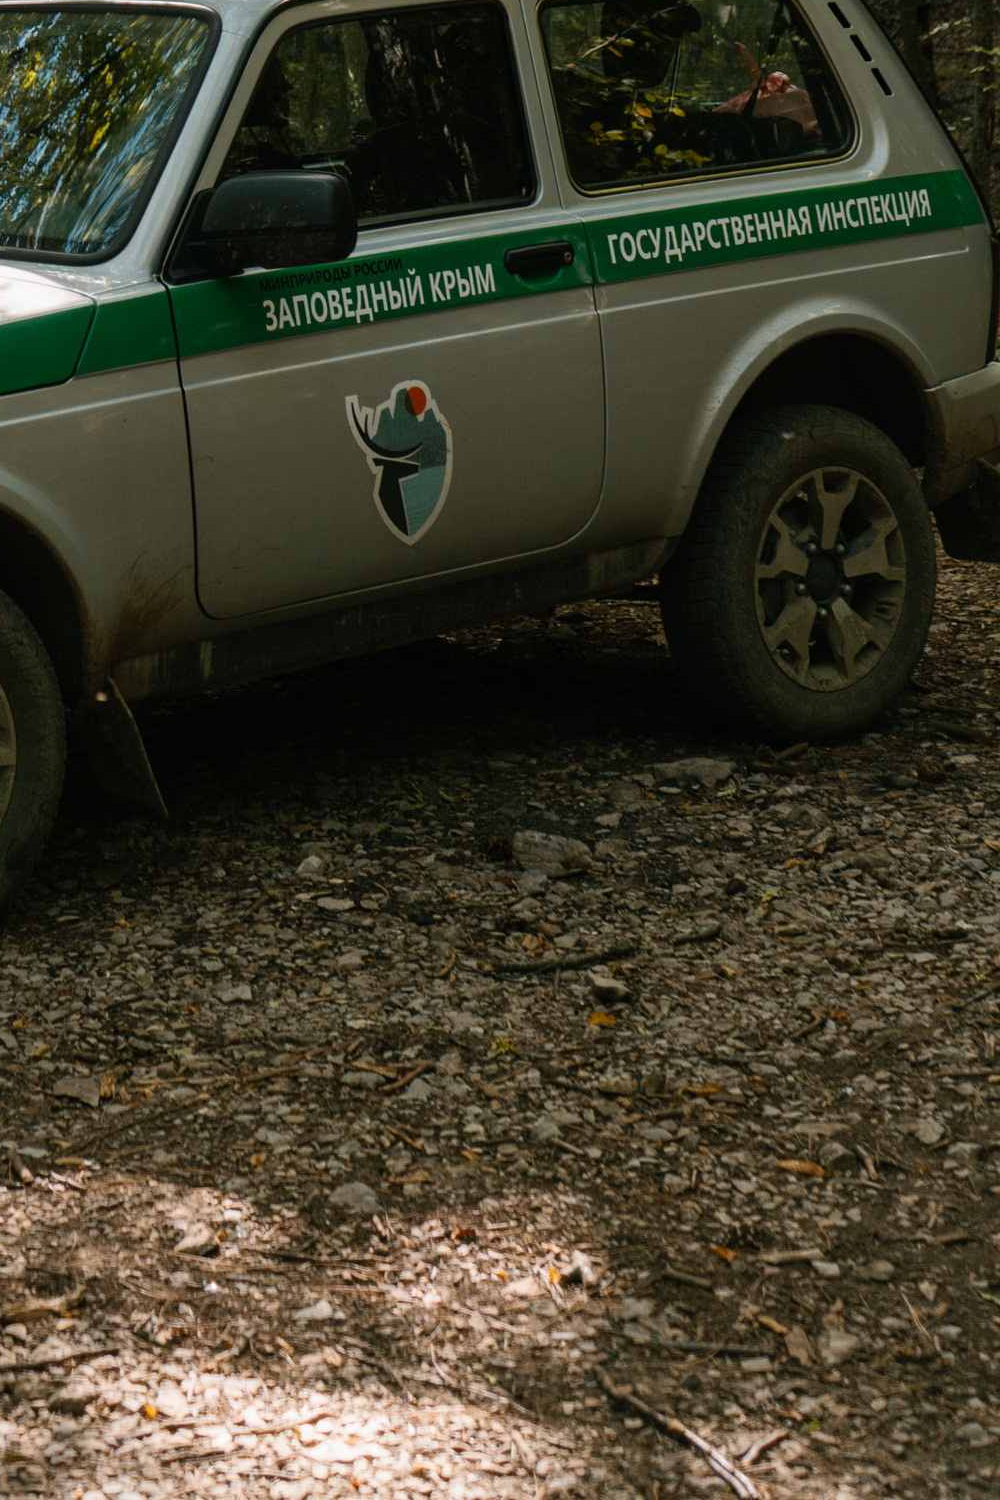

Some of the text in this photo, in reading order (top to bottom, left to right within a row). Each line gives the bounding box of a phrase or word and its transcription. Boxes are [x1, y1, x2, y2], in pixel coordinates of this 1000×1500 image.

[607, 189, 932, 264] ГОСУДАРСТВЕННАЯ ИНСПЕКЦИЯ
[259, 257, 403, 293] МИНПРИРОДЫ РОССИИ
[262, 263, 496, 331] ЗАПОВЕДНЫЙ КРЫМ
